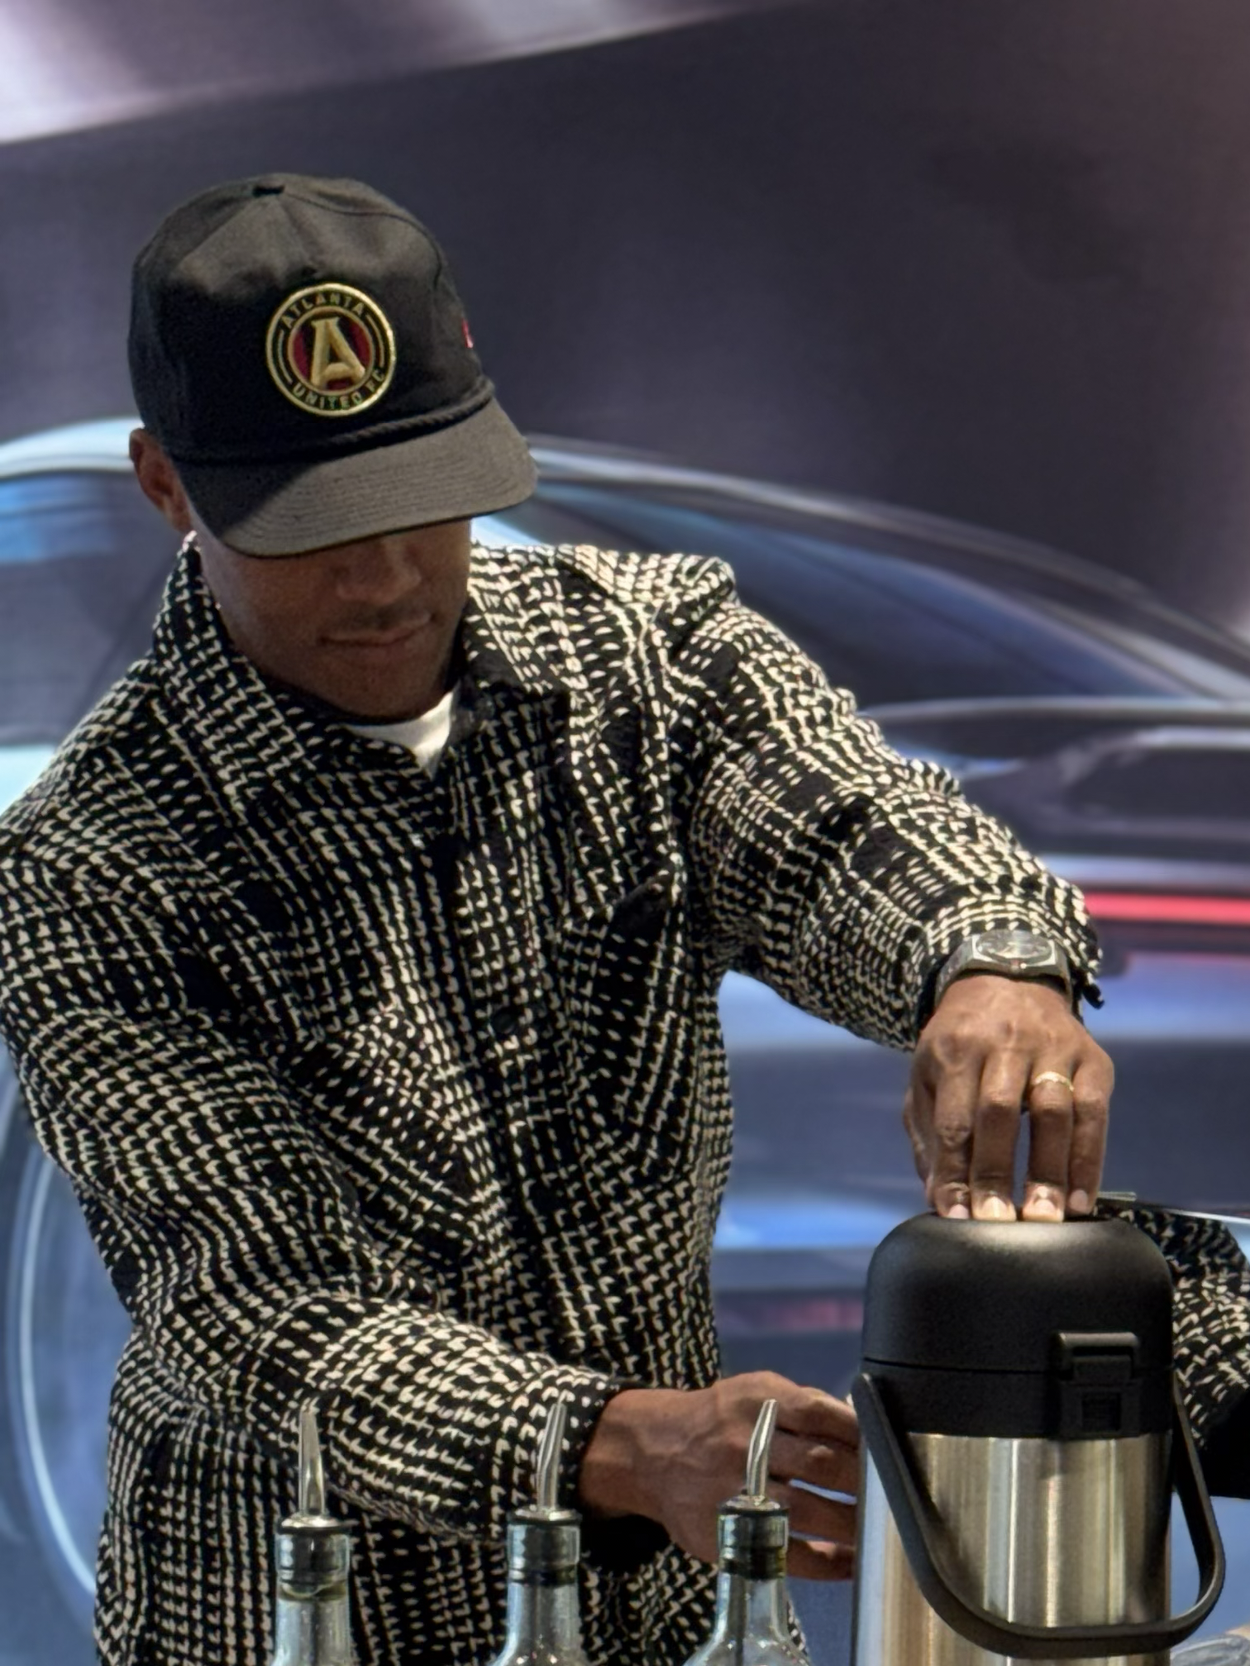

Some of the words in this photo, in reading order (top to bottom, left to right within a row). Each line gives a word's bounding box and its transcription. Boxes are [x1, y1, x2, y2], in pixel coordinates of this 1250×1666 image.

[281, 293, 365, 329] ATLANTA
[311, 317, 366, 388] A
[292, 381, 363, 410] UNITED
[364, 367, 386, 394] FC
